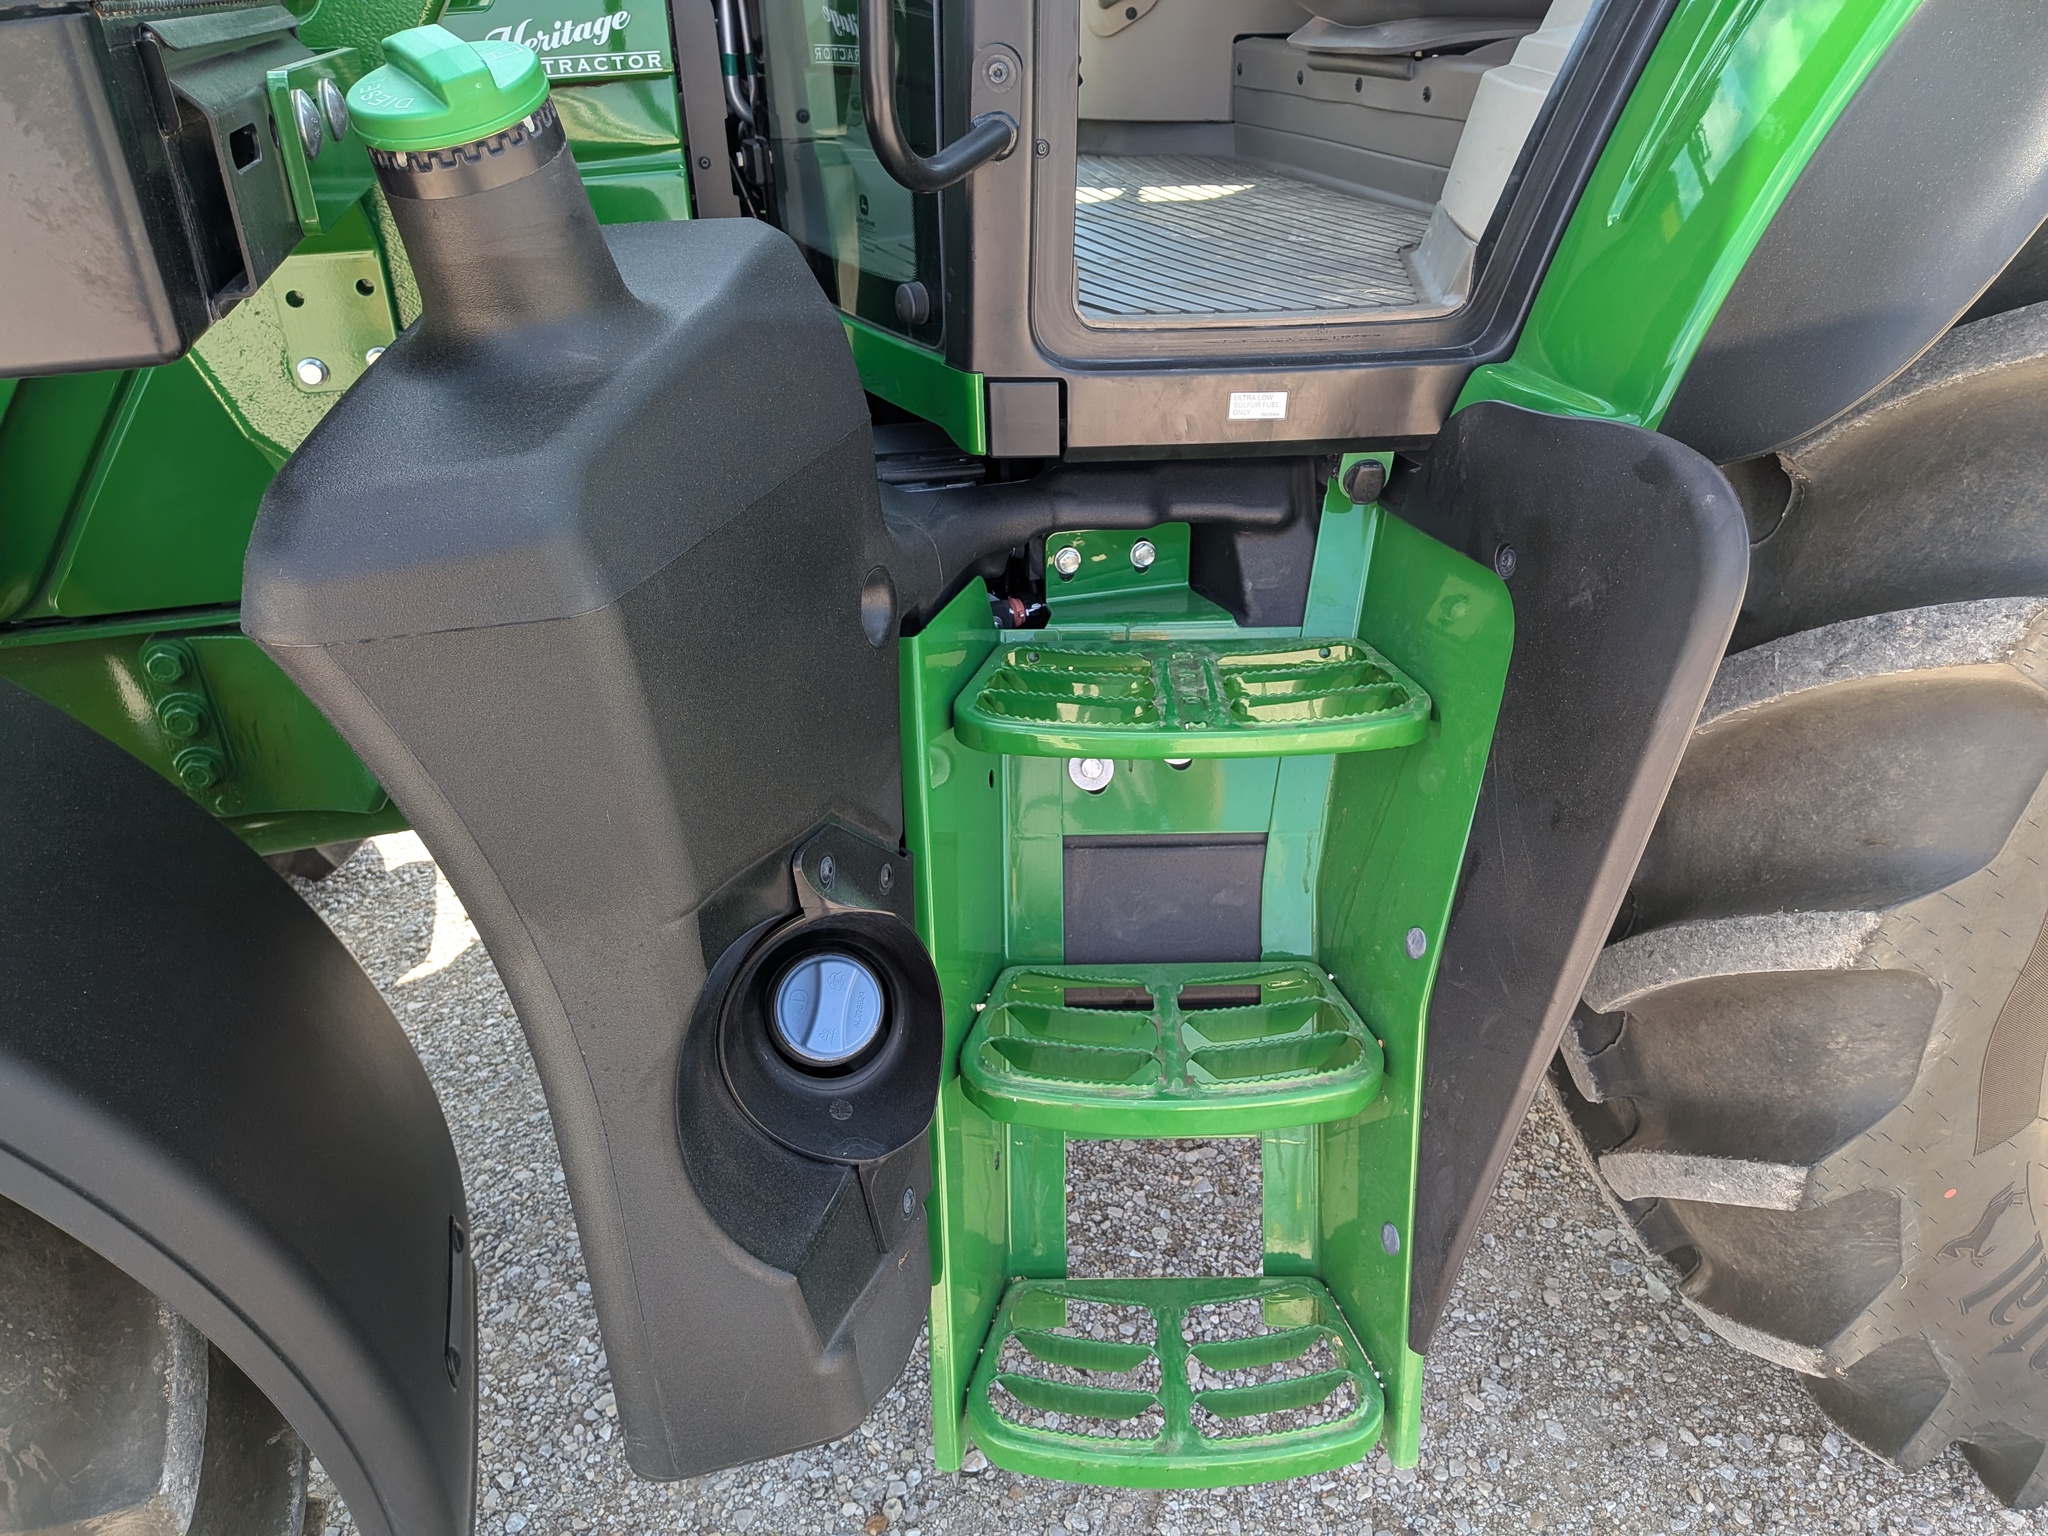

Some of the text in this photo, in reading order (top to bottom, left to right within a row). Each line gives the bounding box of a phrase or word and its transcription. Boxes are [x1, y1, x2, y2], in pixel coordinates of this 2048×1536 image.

[485, 10, 631, 54] Heritage
[542, 54, 662, 75] TRACTOR
[359, 75, 415, 109] DIESEL
